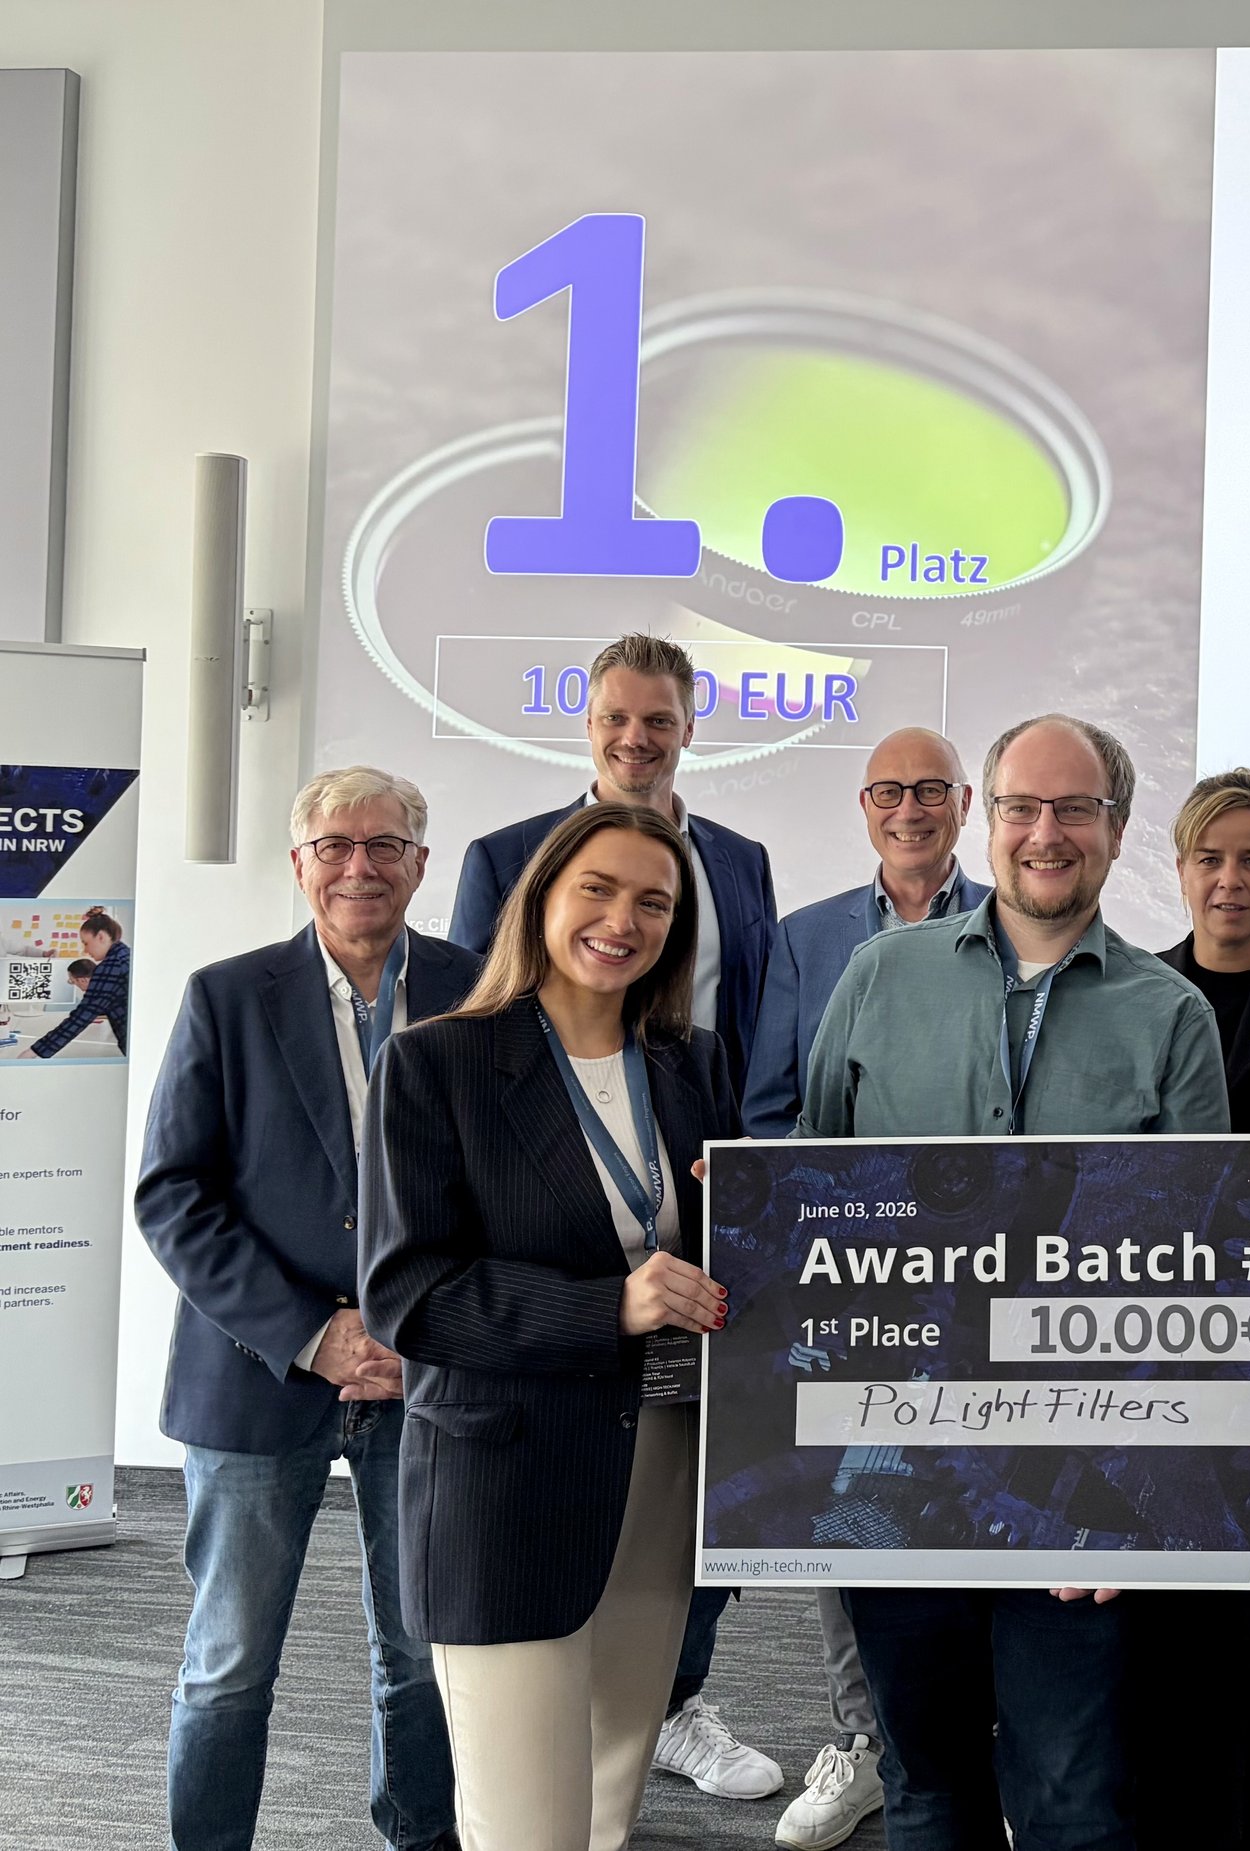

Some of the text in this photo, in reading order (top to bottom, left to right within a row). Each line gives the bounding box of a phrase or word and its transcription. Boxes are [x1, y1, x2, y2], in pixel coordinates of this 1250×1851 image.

[484, 213, 844, 583] 1.
[880, 543, 989, 584] Platz
[851, 610, 902, 631] CPL
[960, 602, 1022, 628] 49mm
[739, 670, 859, 722] EUR
[22, 838, 66, 852] NRW
[1024, 992, 1046, 1042] NMWP.
[0, 1108, 22, 1121] for
[12, 1168, 54, 1180] experts
[57, 1167, 83, 1177] from
[798, 1202, 918, 1221] June 03, 2026
[17, 1226, 64, 1236] mentors
[34, 1239, 93, 1250] readiness.
[799, 1233, 1007, 1285] Award
[1035, 1232, 1216, 1283] Batch
[13, 1285, 67, 1295] increases
[3, 1298, 54, 1310] partners.
[800, 1316, 941, 1347] 1st Place
[704, 1559, 833, 1576] www.high-tech.nrw
